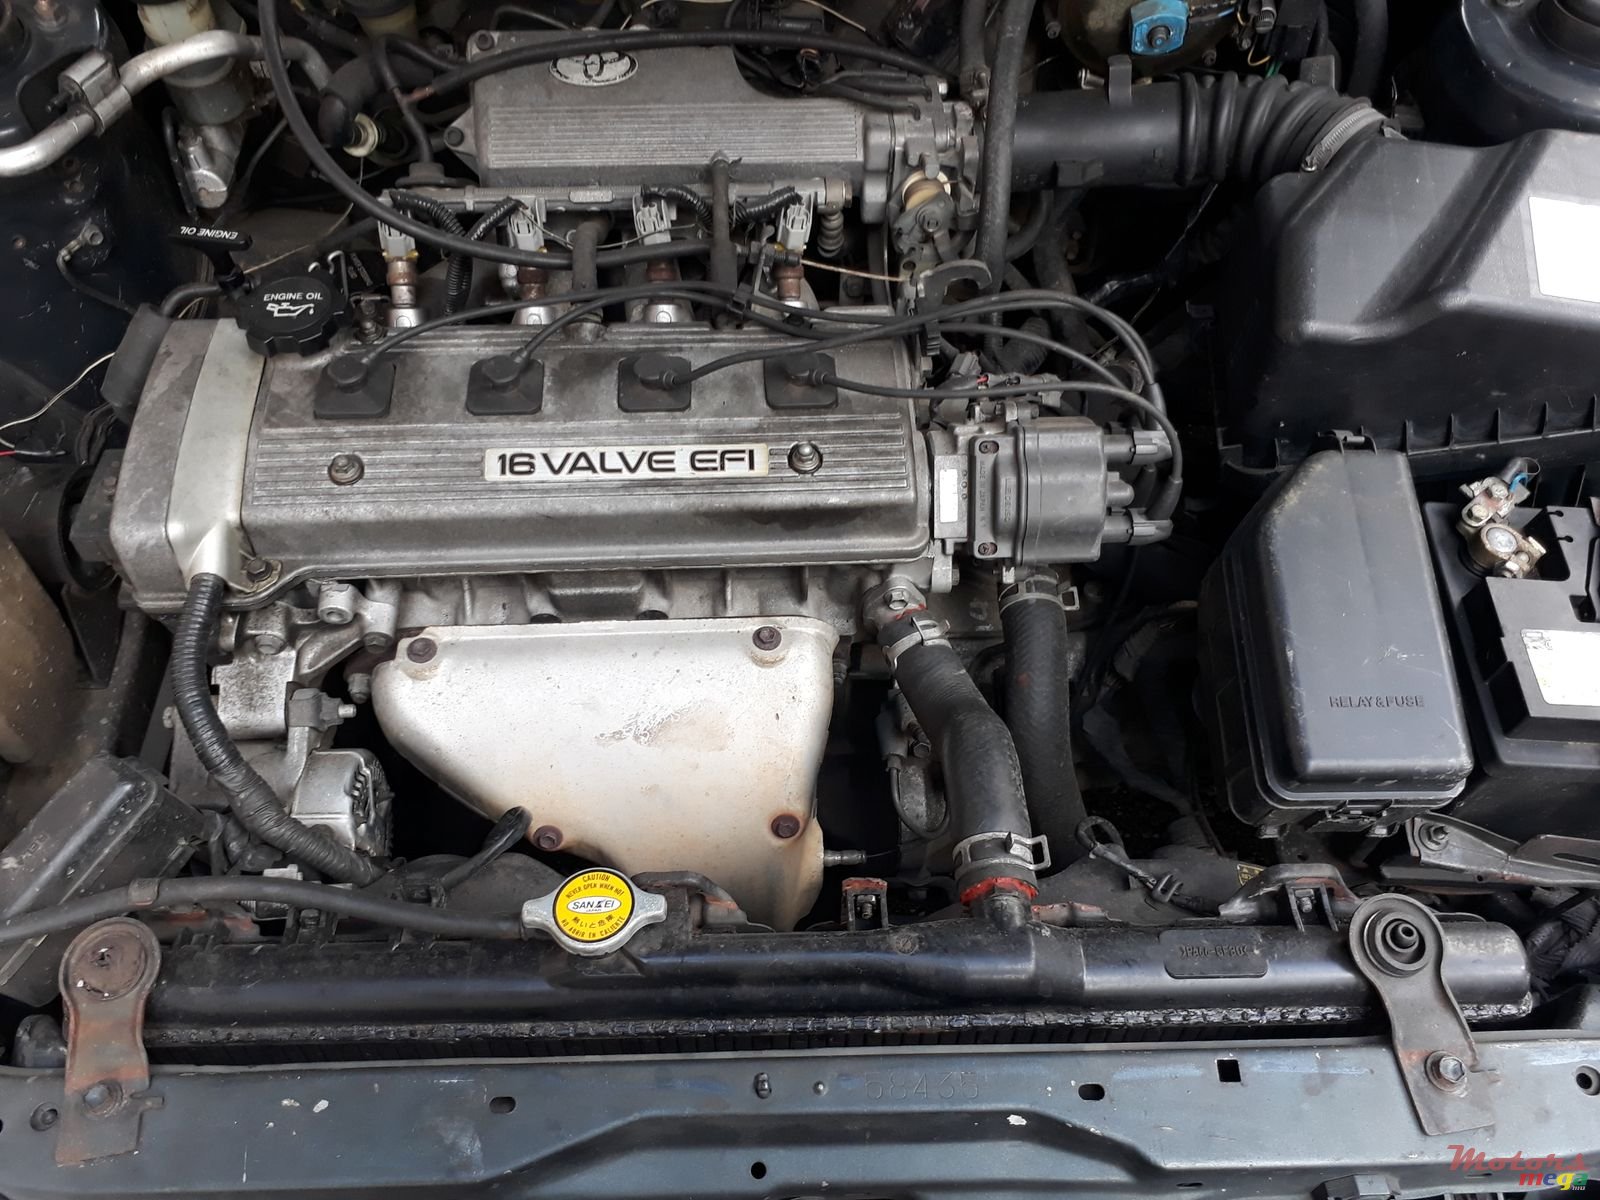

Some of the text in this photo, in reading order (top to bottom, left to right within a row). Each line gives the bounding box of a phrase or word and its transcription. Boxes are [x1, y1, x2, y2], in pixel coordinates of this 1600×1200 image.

[180, 225, 239, 240] ENGINE OIL
[263, 292, 324, 302] ENGINE OIL
[497, 449, 755, 476] 16 VALVE EFI
[1328, 695, 1425, 708] RELAY&FUSE
[582, 873, 611, 882] CAUTION
[565, 886, 582, 899] NEVER
[583, 882, 597, 890] OPEN
[599, 882, 614, 891] WHEN
[561, 918, 569, 928] NO
